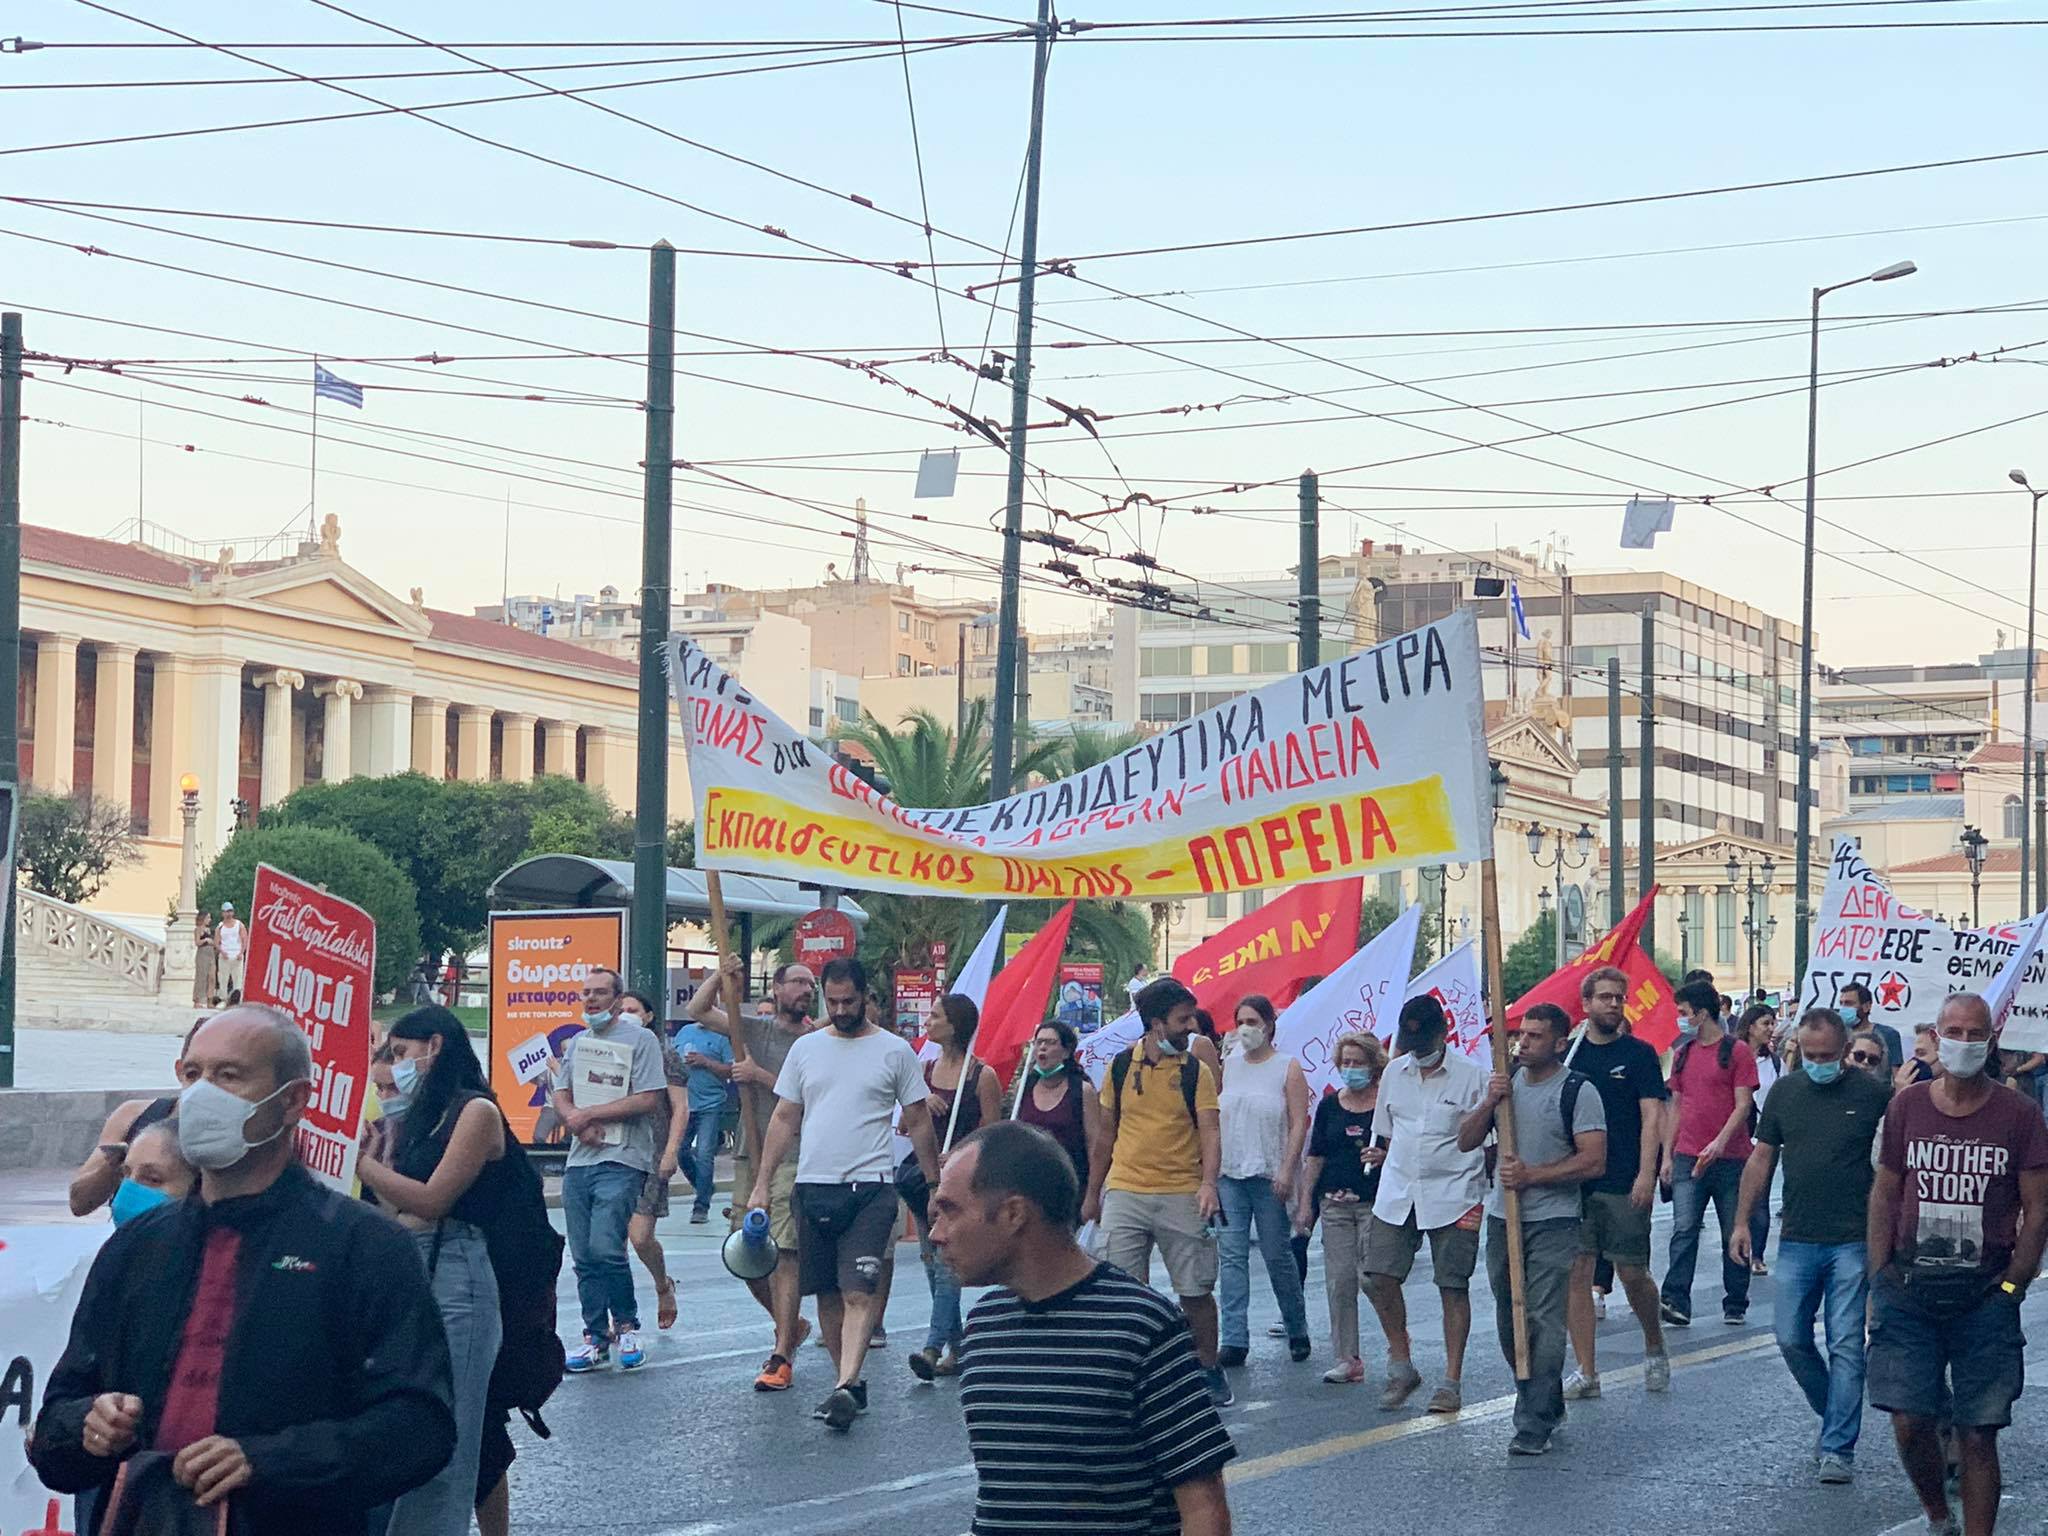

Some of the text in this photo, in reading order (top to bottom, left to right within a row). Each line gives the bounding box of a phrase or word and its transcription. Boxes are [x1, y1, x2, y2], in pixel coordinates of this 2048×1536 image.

[1303, 626, 1451, 725] ΜΕΤΡΑ
[1220, 715, 1380, 806] ΠΑΙΔΕΙΑ
[1188, 796, 1397, 893] ΠΟΡΕΙΑ
[1840, 886, 1892, 920] ΔΕΝ
[507, 936, 565, 951] skroutz
[262, 943, 354, 1028] Λεφτά
[518, 1047, 547, 1073] plus
[1906, 1140, 2010, 1176] ANOTHER
[1917, 1170, 1990, 1203] STORY
